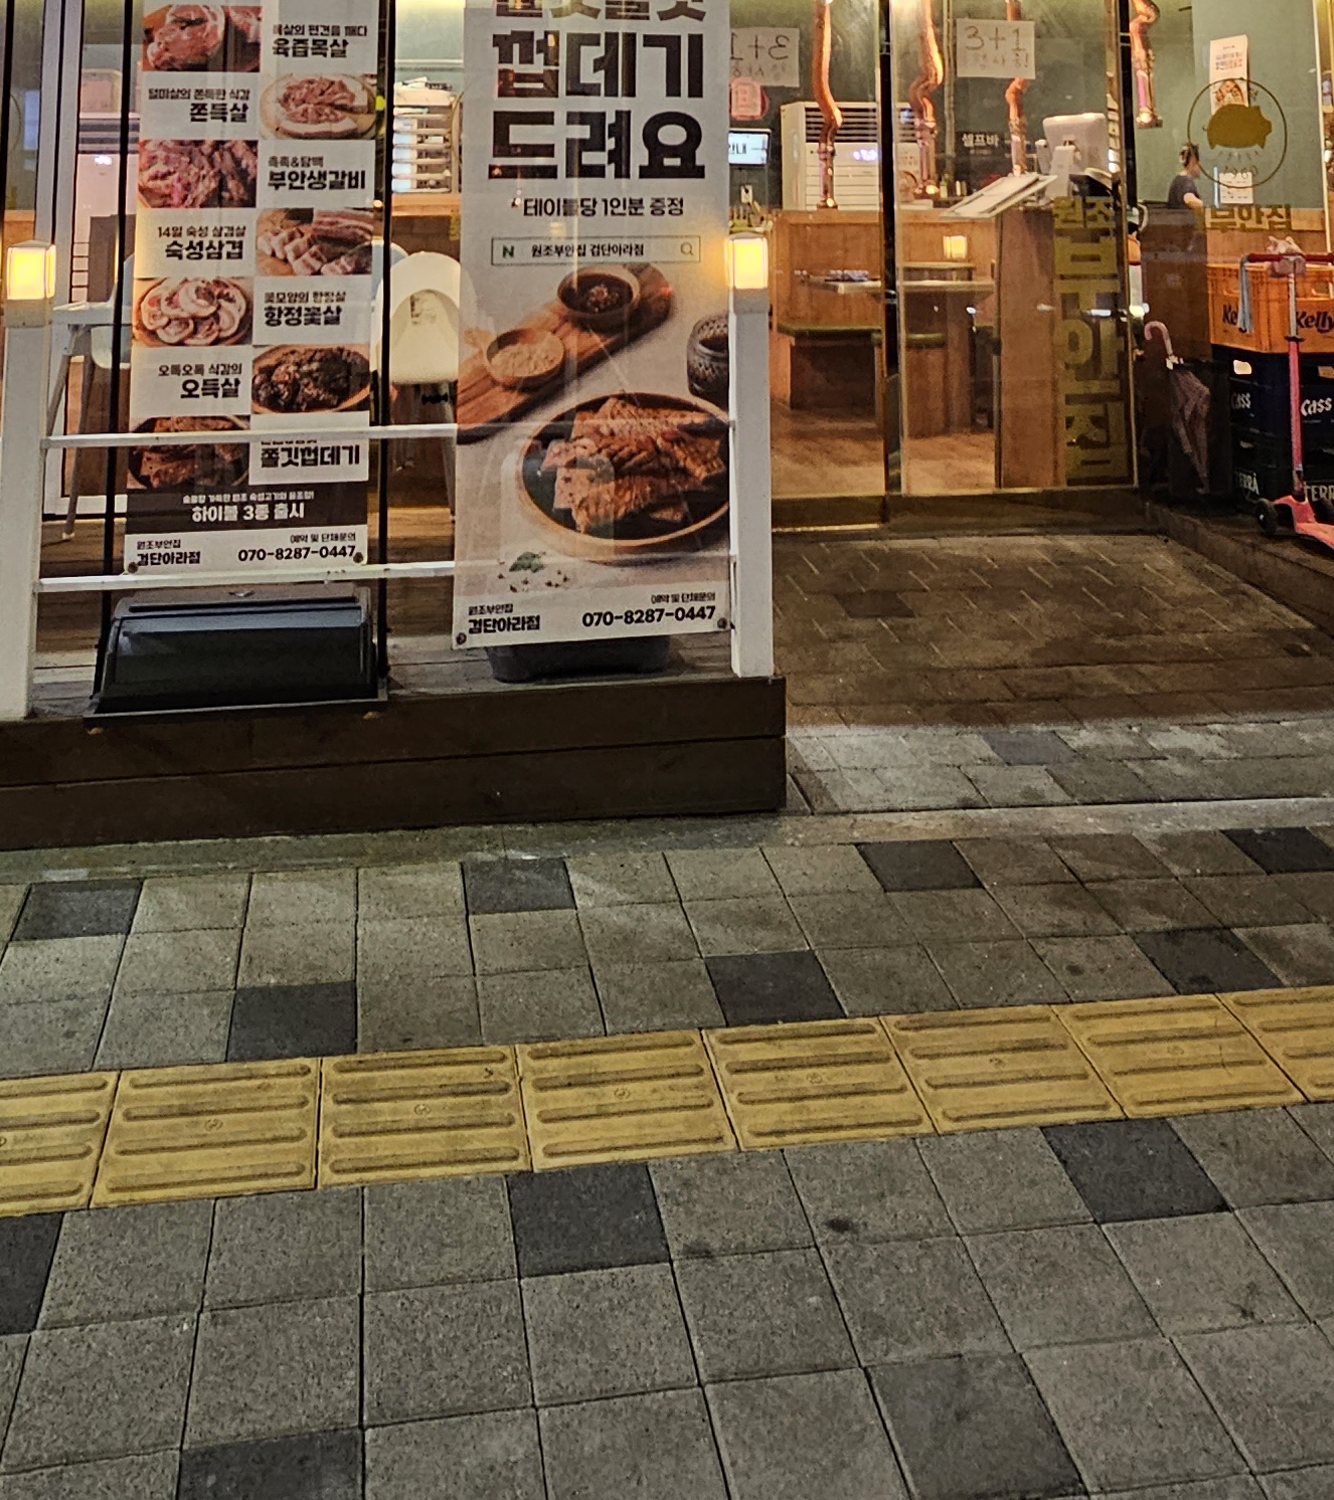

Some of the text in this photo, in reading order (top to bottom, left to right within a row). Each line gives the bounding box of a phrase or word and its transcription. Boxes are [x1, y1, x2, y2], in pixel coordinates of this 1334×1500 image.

[272, 37, 349, 58] 육즙목살
[965, 25, 1026, 52] 3+1
[492, 30, 704, 98] 껍데기
[189, 102, 249, 123] 쫀득살
[488, 109, 706, 179] 드려요
[267, 169, 366, 191] 부안생갈비
[602, 197, 645, 217] 1인분
[650, 196, 684, 217] 증정
[158, 226, 183, 238] 14일
[186, 225, 208, 238] 숙성
[165, 240, 243, 260] 숙성삼겹
[502, 244, 515, 257] N
[590, 243, 644, 257] 검단아라점
[264, 305, 342, 327] 항정꽃살
[1295, 311, 1334, 334] Kelly
[208, 363, 243, 375] 식감의
[1300, 397, 1333, 417] Cass
[261, 445, 360, 468] 쫄깃껍데기
[136, 551, 201, 567] 검단아라점
[237, 544, 356, 562] 070-8287-0447
[468, 615, 541, 634] 검단아라점
[582, 605, 716, 628] 070-8287-0447
